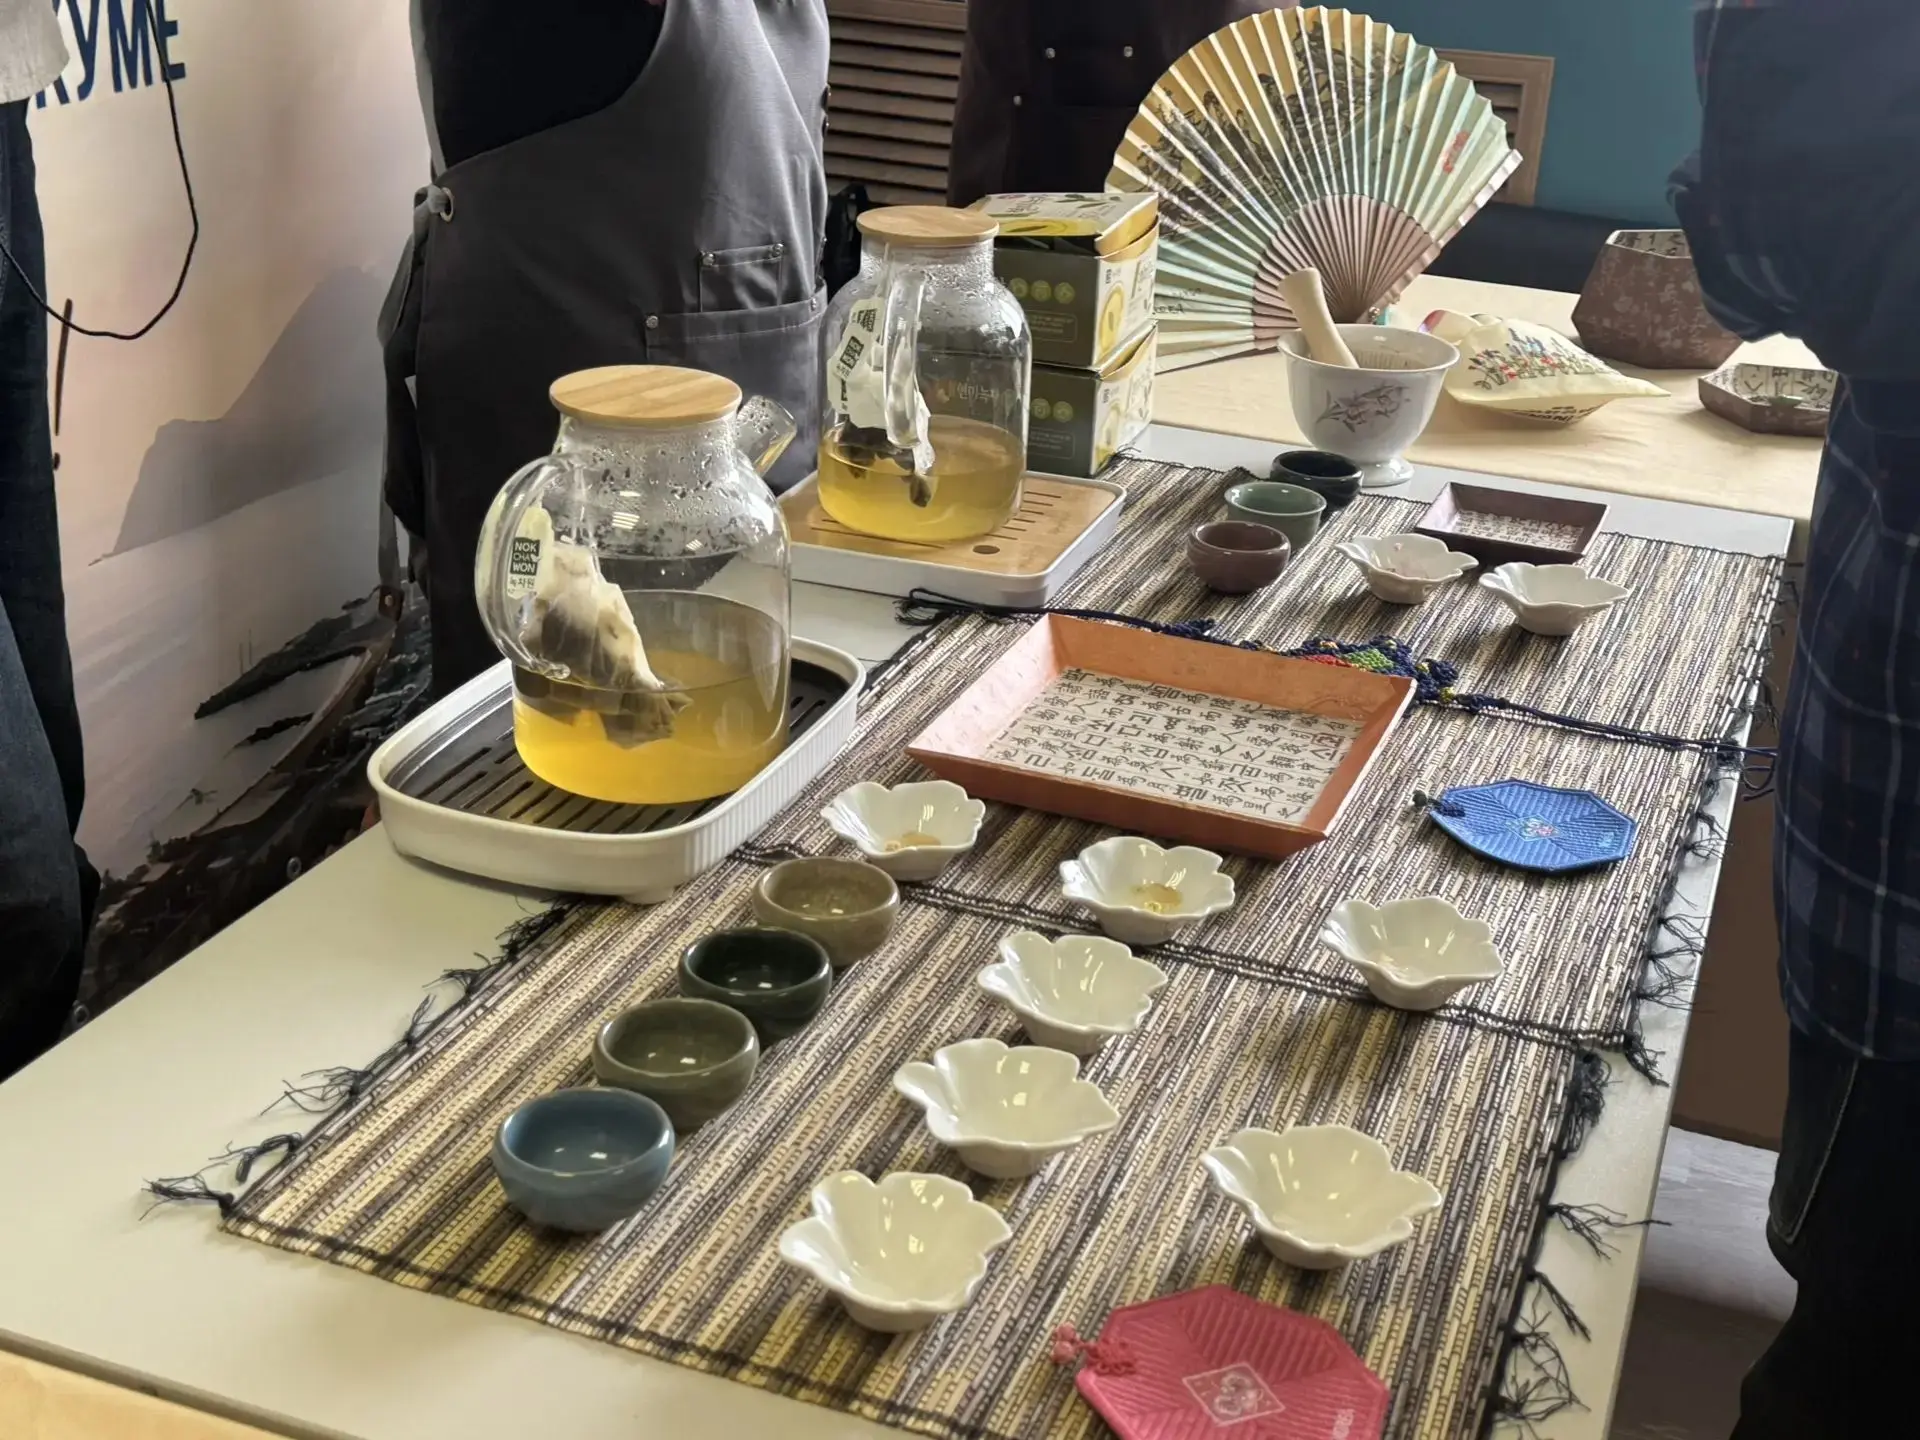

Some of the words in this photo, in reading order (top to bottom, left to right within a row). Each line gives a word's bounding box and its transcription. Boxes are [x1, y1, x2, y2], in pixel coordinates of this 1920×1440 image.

[36, 0, 186, 109] УМЕ
[514, 541, 537, 552] NOK
[513, 552, 531, 561] CHA
[512, 561, 535, 573] WON
